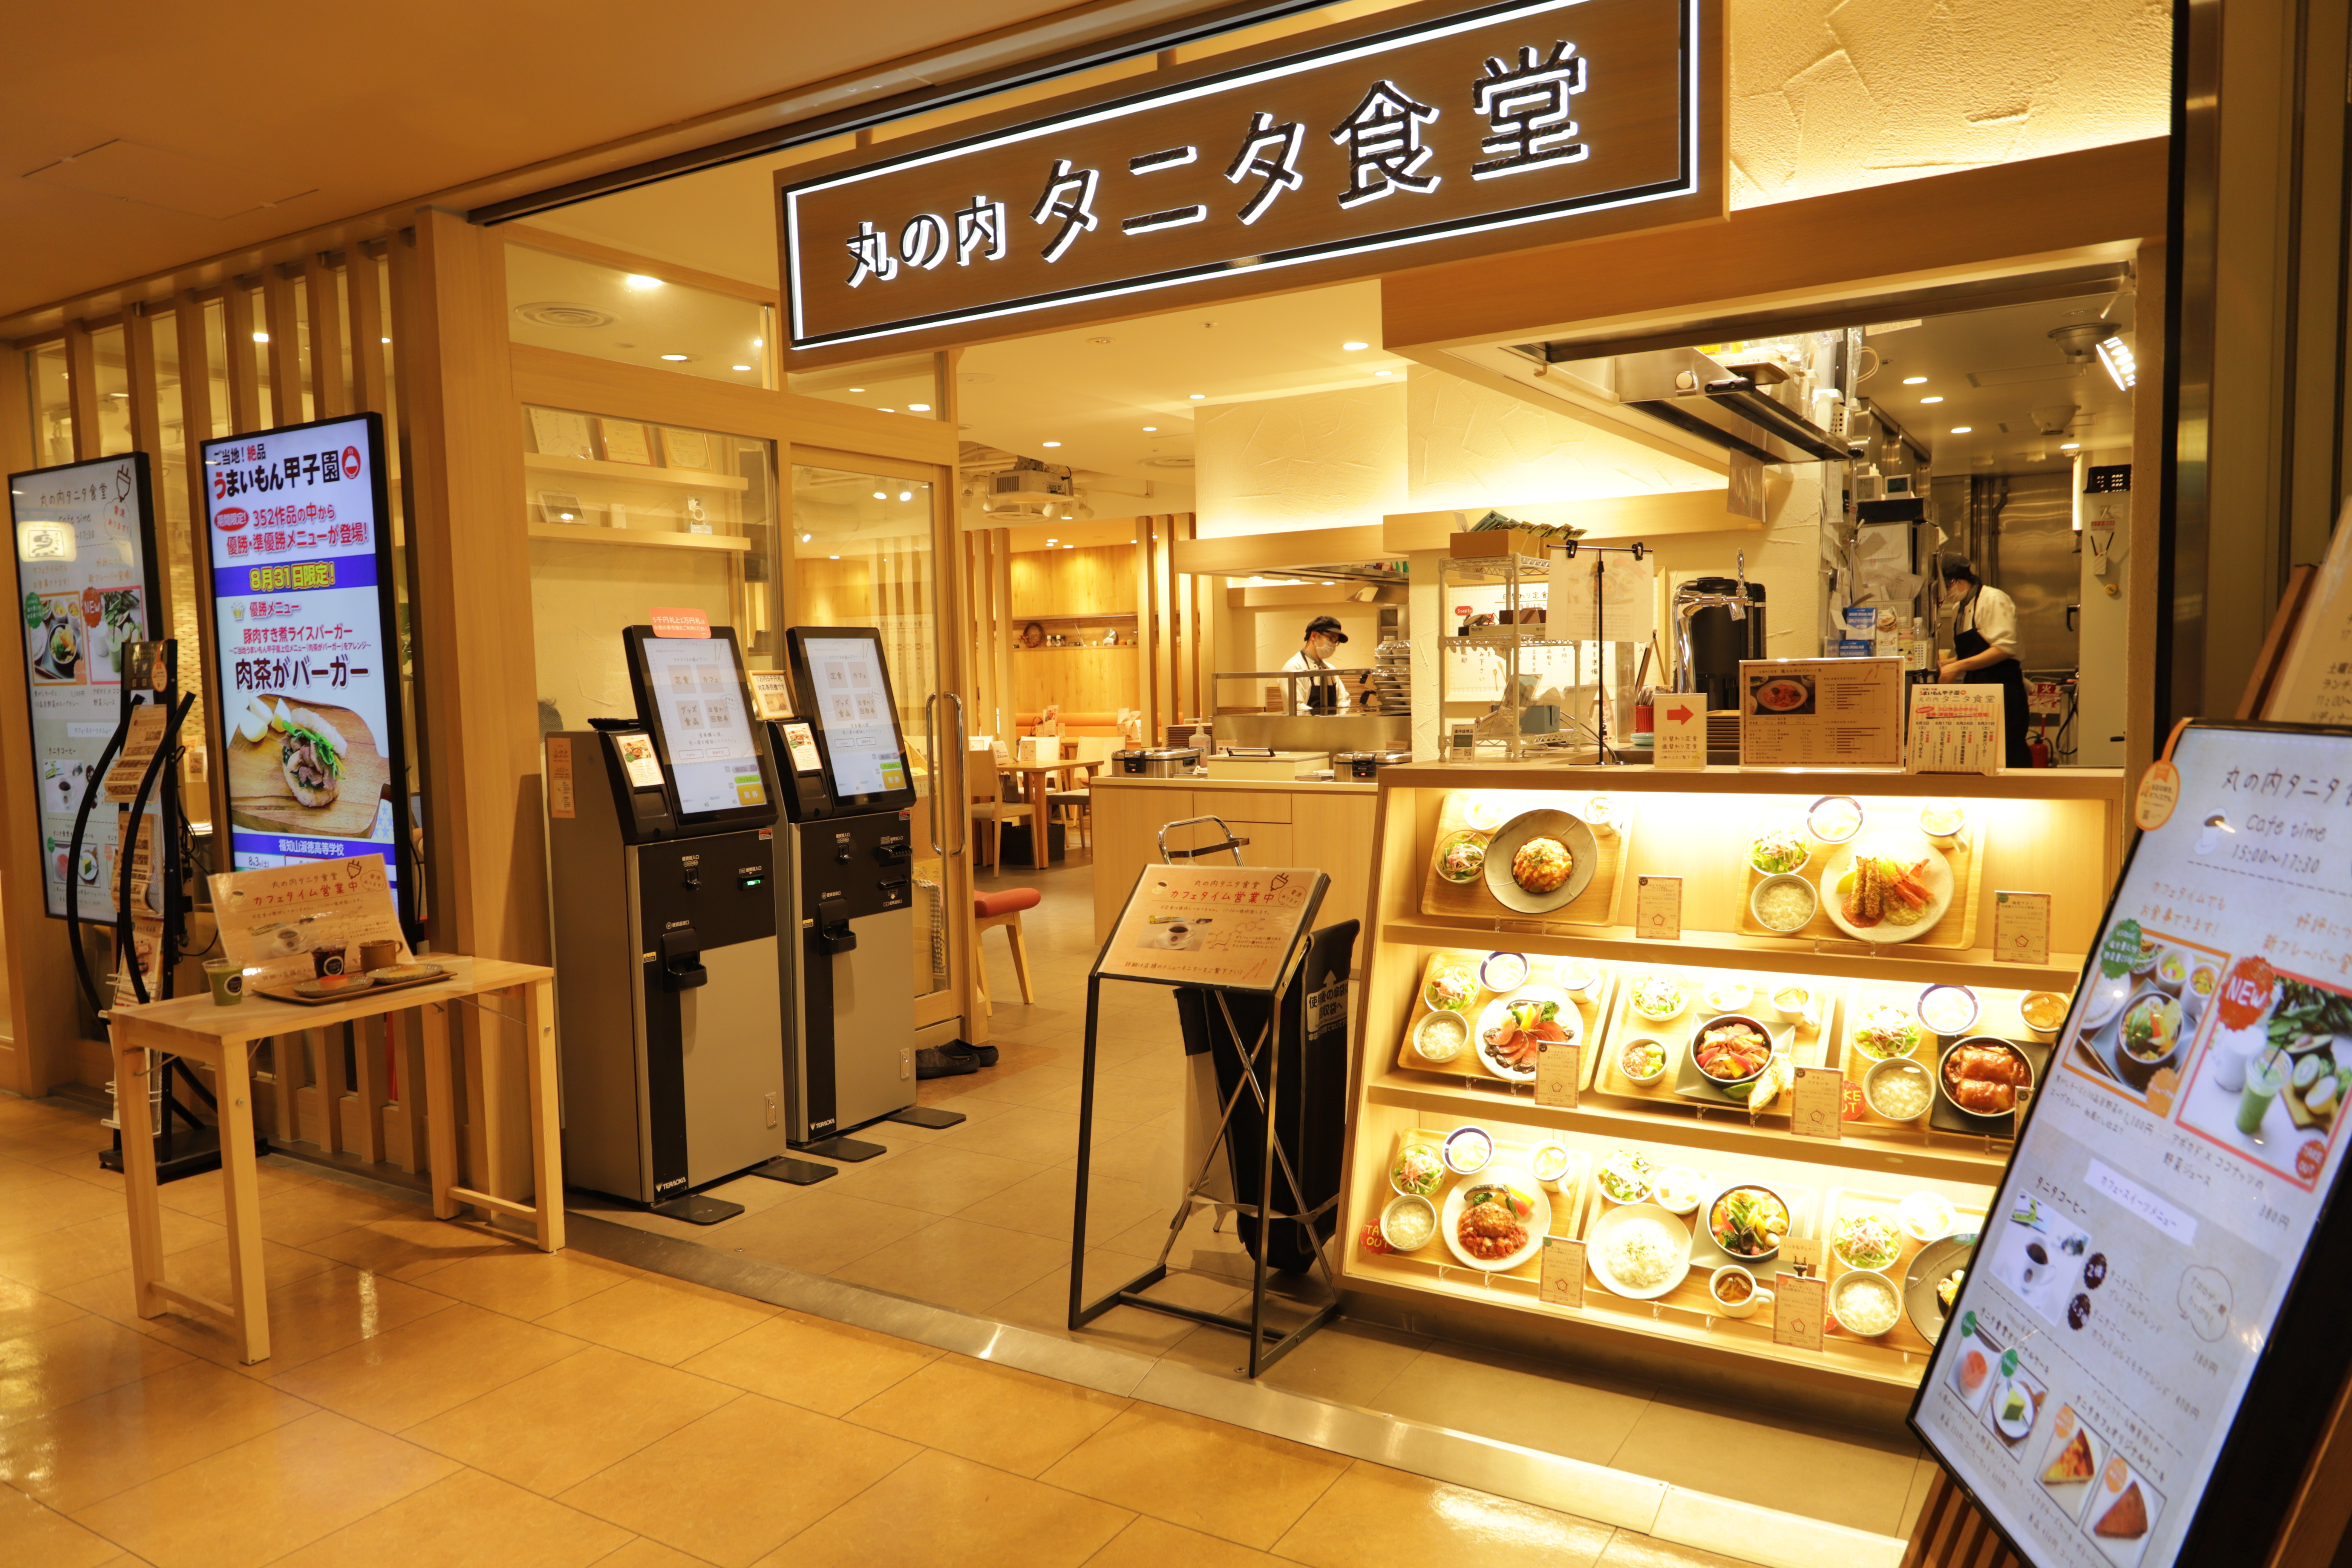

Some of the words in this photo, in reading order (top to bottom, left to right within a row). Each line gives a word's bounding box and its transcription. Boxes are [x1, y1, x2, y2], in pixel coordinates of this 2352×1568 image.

[214, 450, 340, 500] うまいもん甲子園
[40, 482, 107, 508] 丸の内タニタ食堂
[253, 502, 335, 527] 352作品の中から
[227, 522, 368, 555] 優勝・準優勝メニューが登場!
[33, 564, 68, 574] カフェタイムでも
[250, 561, 335, 591] 8月31日限定!
[84, 600, 101, 614] NEW
[250, 601, 300, 618] 優勝メニュー
[652, 616, 705, 625] 5千円札と1万円札は
[243, 623, 353, 644] 豚肉すき煮ライスバーガー
[236, 654, 368, 690] 肉茶がバーガー
[674, 676, 689, 684] 定食
[1918, 695, 1995, 703] 丸の内タニタ食堂
[681, 705, 697, 714] グッズ
[839, 709, 851, 718] 食品
[684, 717, 699, 726] 食品
[48, 747, 77, 755] タニタコーヒー
[744, 790, 758, 799] 発券
[2246, 814, 2284, 837] Cafe
[2291, 822, 2327, 842] time
[278, 839, 345, 856] 福知山淑徳高等学校
[272, 872, 338, 888] 丸の内タニタ食堂
[1194, 879, 1260, 890] 丸の内タニタ食堂
[254, 881, 358, 905] カフェタイム営業中
[1170, 891, 1274, 904] カフェタイム営業中
[1281, 894, 1301, 905] あります!
[1291, 889, 1302, 898] 電源
[2154, 881, 2225, 911] カフェタイムでも
[2140, 905, 2220, 937] お食事できます!
[1124, 961, 1243, 975] 詳細は店頭のメニューモニターをご覧下さい!
[2225, 975, 2267, 1009] NEW
[1843, 1089, 1862, 1102] KE
[2050, 1088, 2081, 1109] スープカレー
[815, 1118, 835, 1129] TERAOKA
[2162, 1151, 2213, 1188] 野菜ジュース
[662, 1176, 686, 1190] TERAOKA
[2035, 1174, 2087, 1217] タニタコーヒー
[2088, 1263, 2104, 1278] 2倍
[1980, 1307, 2050, 1376] タニタ食堂オリジナルケーキ
[2074, 1394, 2165, 1483] タニタカフェオリジナルケーキ
